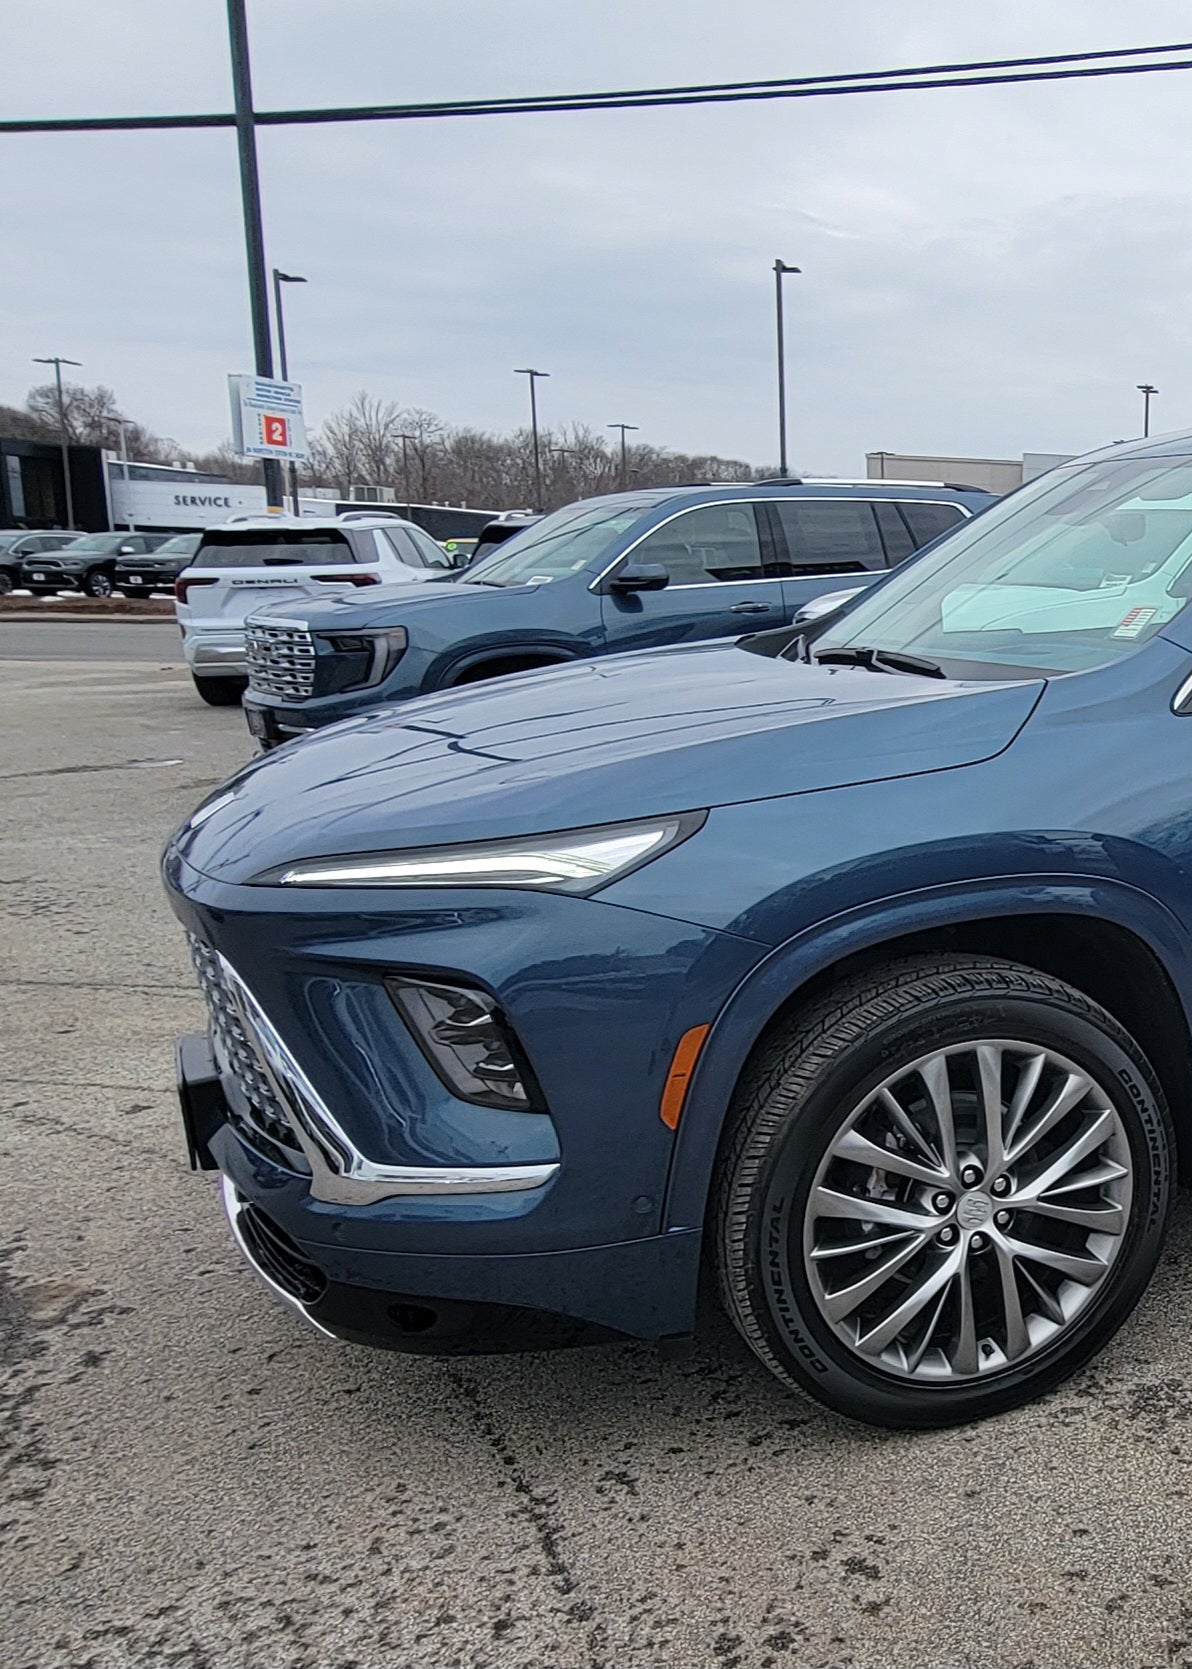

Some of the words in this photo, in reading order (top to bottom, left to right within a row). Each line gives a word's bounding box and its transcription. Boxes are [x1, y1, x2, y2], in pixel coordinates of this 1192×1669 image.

[271, 422, 284, 442] 2
[174, 495, 231, 508] SERVICE
[1118, 1068, 1162, 1233] CONTINENTAL
[768, 1197, 829, 1374] CONTINENTAL
